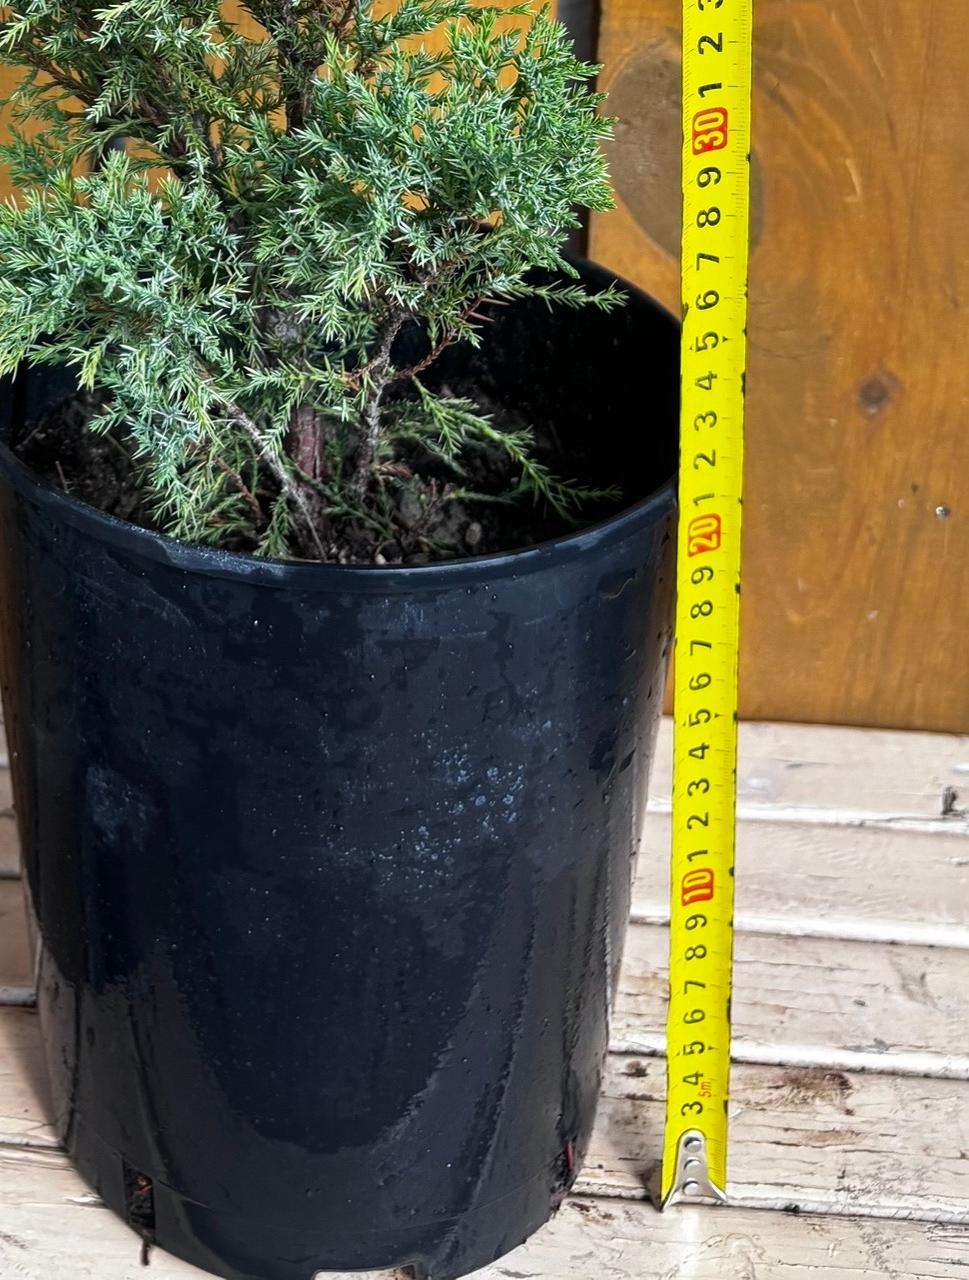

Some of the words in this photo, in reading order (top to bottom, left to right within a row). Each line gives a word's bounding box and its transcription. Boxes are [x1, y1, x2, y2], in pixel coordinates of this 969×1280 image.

[698, 32, 723, 55] 2
[698, 82, 722, 98] 1
[694, 110, 726, 153] 30
[697, 166, 721, 188] 9
[696, 206, 721, 228] 8
[696, 252, 720, 271] 7
[695, 289, 720, 310] 6
[695, 331, 719, 352] 5
[694, 370, 718, 391] 4
[694, 410, 717, 430] 3
[693, 448, 716, 471] 2
[693, 492, 715, 507] 1
[689, 516, 719, 554] 20
[691, 566, 714, 584] 9
[690, 600, 714, 619] 8
[690, 640, 712, 656] 7
[689, 673, 712, 690] 6
[689, 708, 711, 727] 5
[688, 742, 710, 760] 4
[687, 778, 710, 796] 3
[687, 811, 709, 830] 2
[687, 849, 708, 862] 1
[683, 870, 712, 904] 10
[685, 914, 707, 931] 9
[685, 944, 707, 961] 8
[684, 980, 706, 995] 7
[683, 1008, 706, 1024] 6
[683, 1041, 705, 1056] 5
[682, 1071, 704, 1086] 4
[681, 1101, 703, 1117] 3
